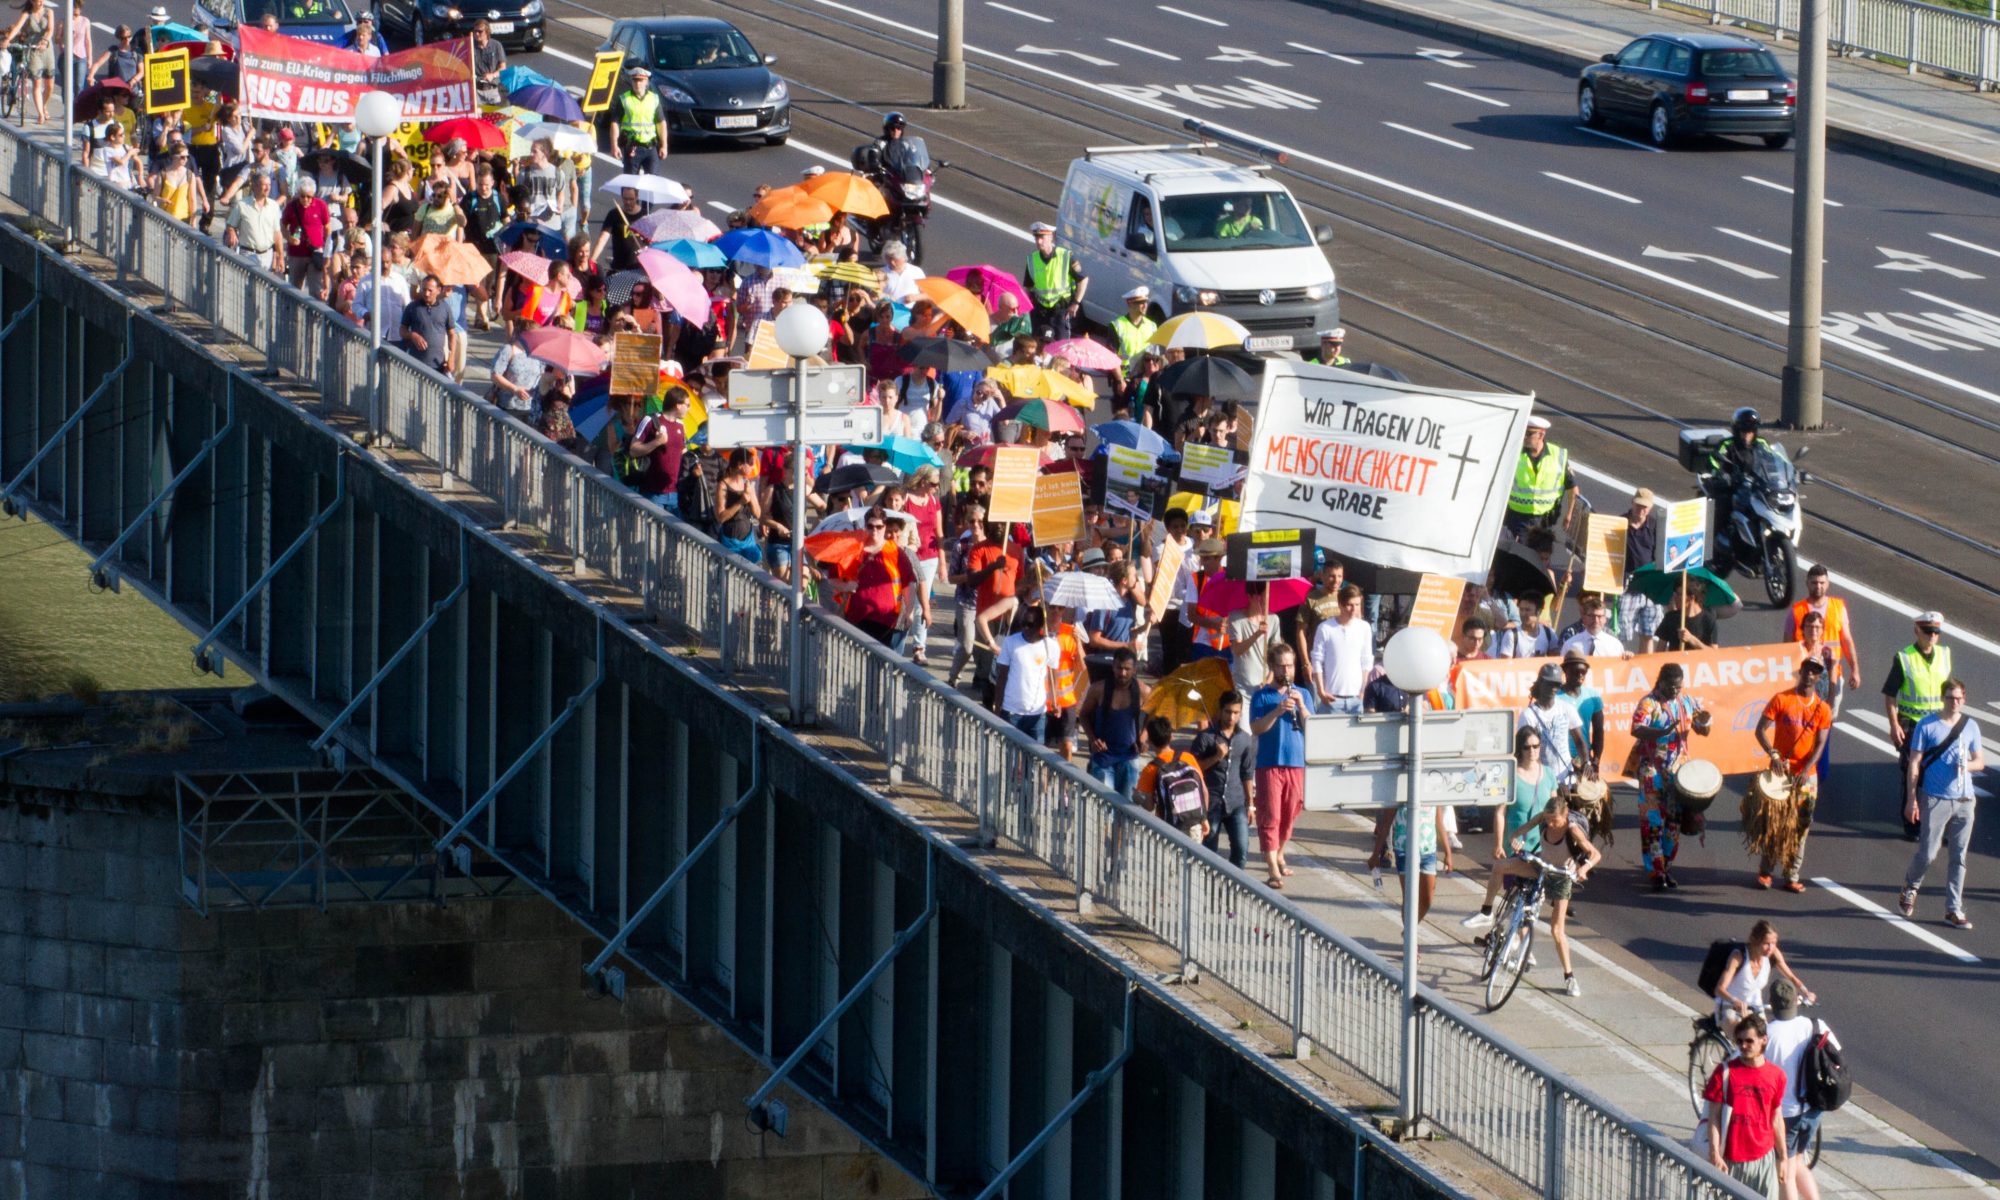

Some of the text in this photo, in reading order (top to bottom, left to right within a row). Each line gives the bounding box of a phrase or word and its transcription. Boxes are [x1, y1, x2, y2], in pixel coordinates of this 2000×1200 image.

[260, 60, 284, 73] zum
[286, 61, 331, 81] EU-Krieg
[334, 71, 368, 85] gegen
[297, 85, 350, 114] AUS
[1097, 84, 1318, 110] PKW
[1304, 397, 1446, 450] WIR TRAGEN DIE
[1265, 436, 1439, 496] MENSCHLICHKEIT
[1288, 480, 1388, 520] ZU GRABE
[1466, 655, 1793, 697] UMBLLA ARCH
